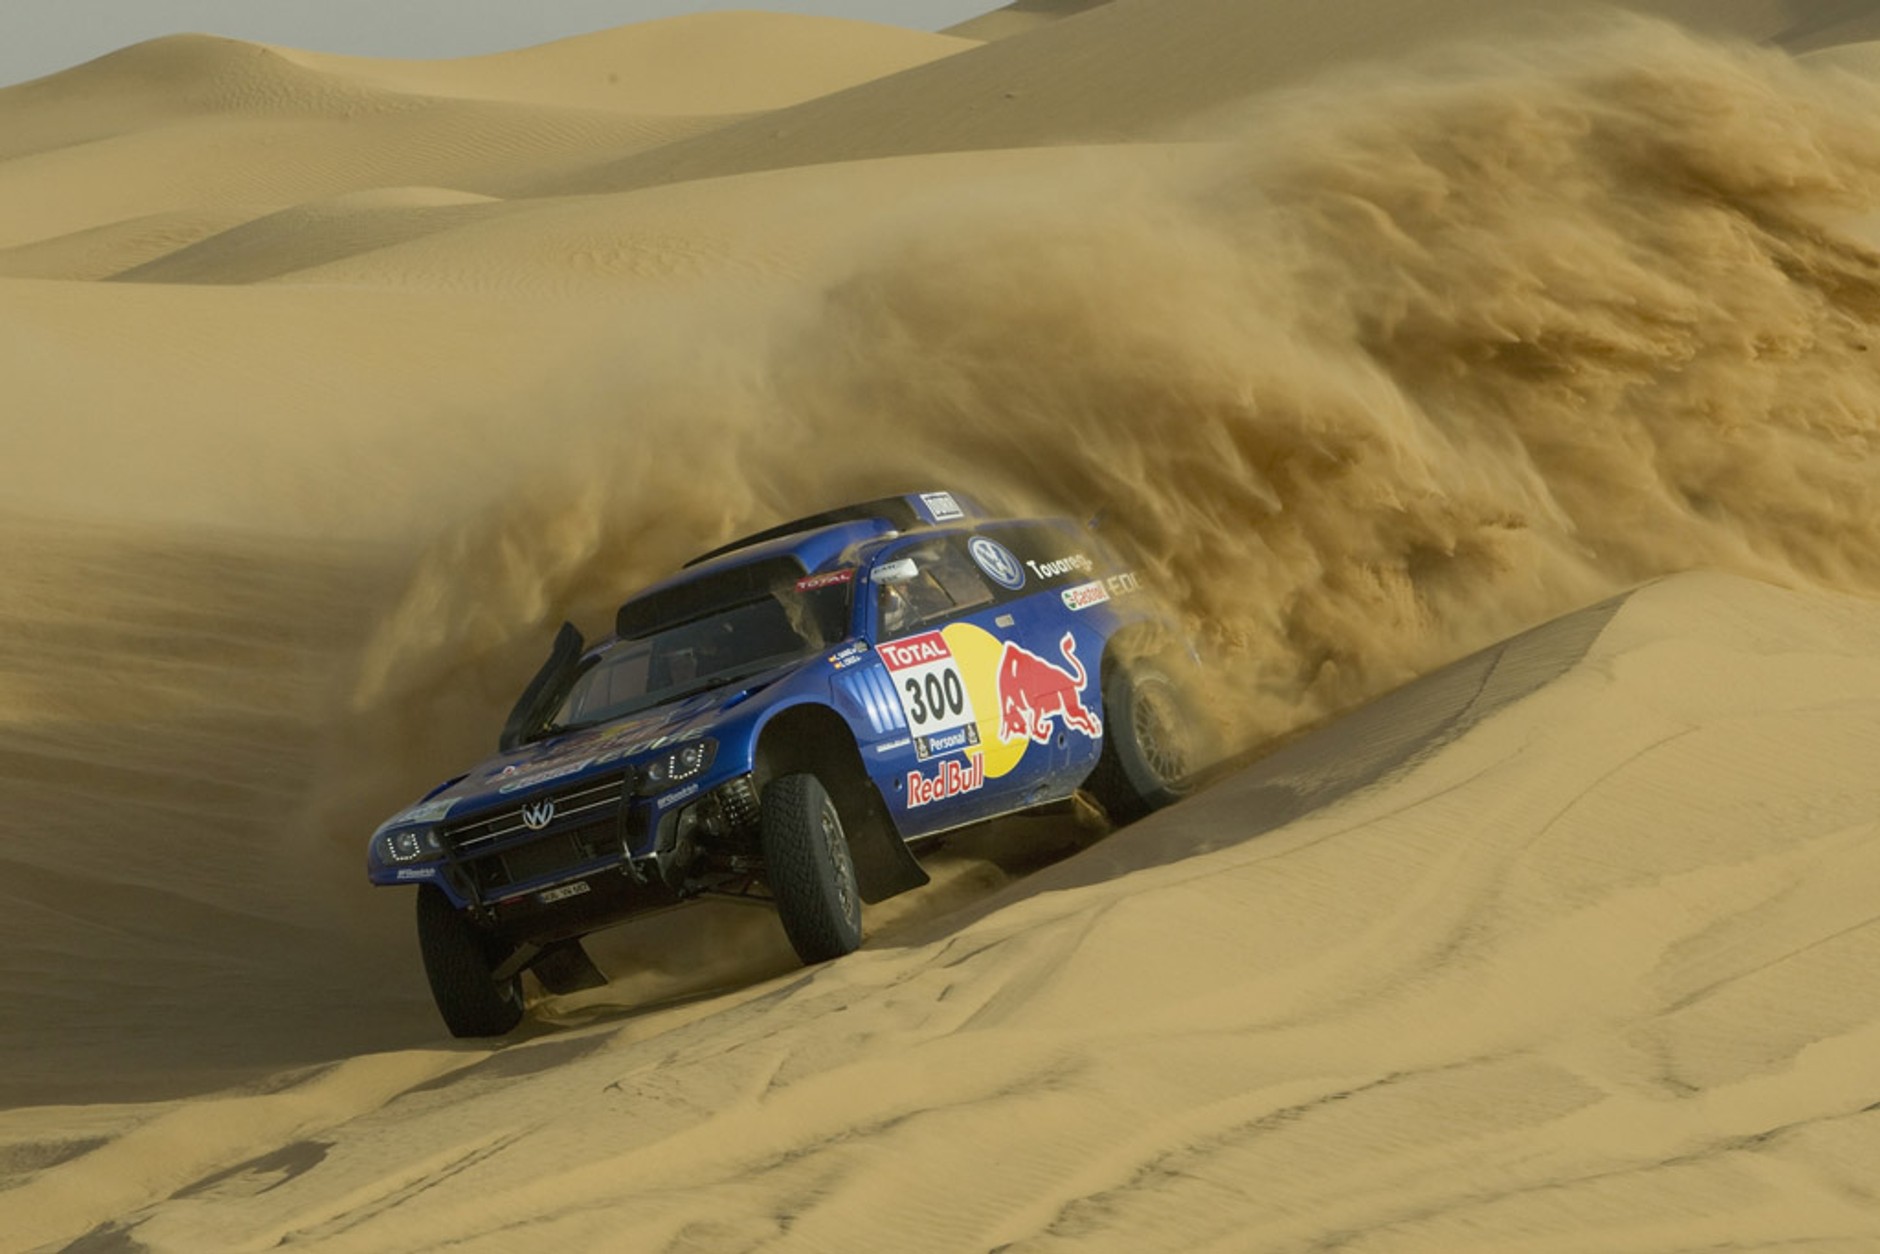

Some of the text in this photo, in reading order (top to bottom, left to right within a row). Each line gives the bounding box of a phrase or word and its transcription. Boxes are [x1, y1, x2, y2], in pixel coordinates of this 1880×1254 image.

[797, 574, 851, 589] TOTAL
[882, 640, 947, 667] TOTAL
[905, 668, 964, 725] 300
[928, 730, 966, 752] Personal
